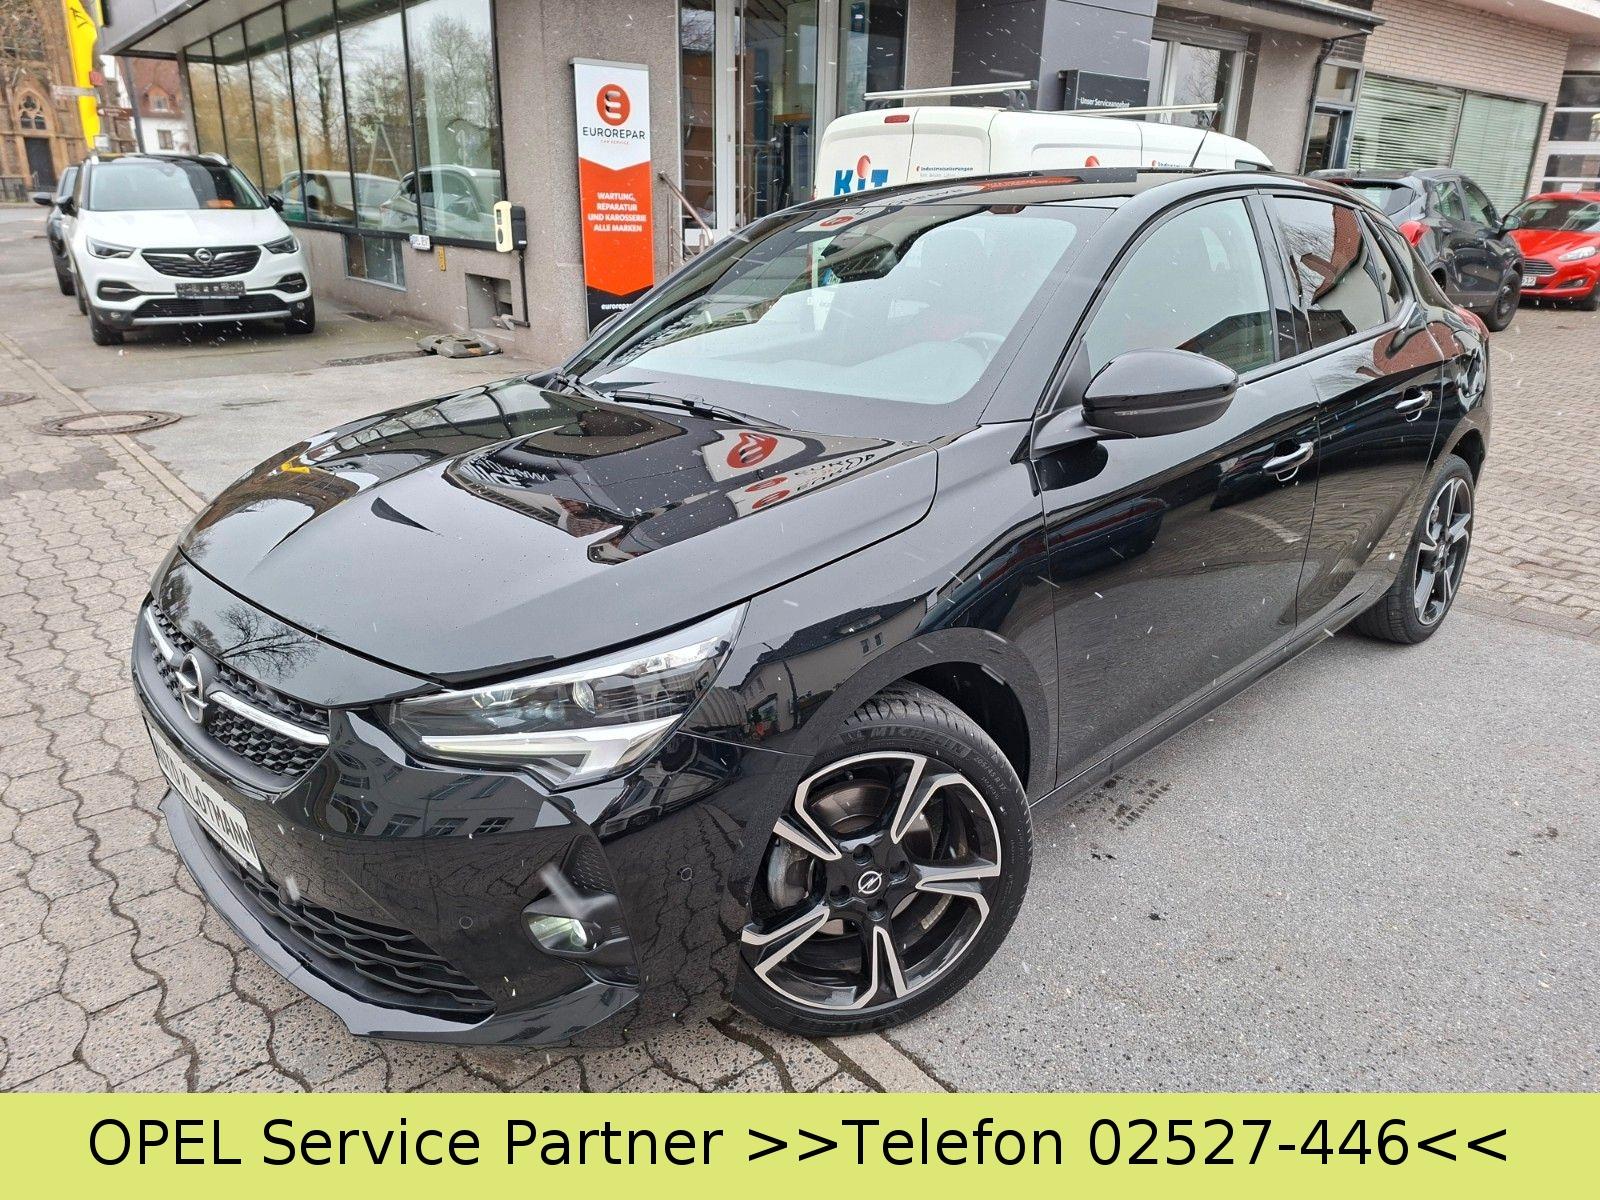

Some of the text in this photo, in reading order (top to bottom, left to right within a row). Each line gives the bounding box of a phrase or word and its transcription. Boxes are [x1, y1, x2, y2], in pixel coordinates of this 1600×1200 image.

[1080, 96, 1130, 108] Unser Serviceangebot
[582, 126, 646, 140] EUROREPAR
[597, 192, 636, 201] WARTUNG,
[596, 202, 638, 211] REPARATUR
[588, 213, 646, 222] UND KAROSSERIE
[611, 224, 642, 232] MARKEN
